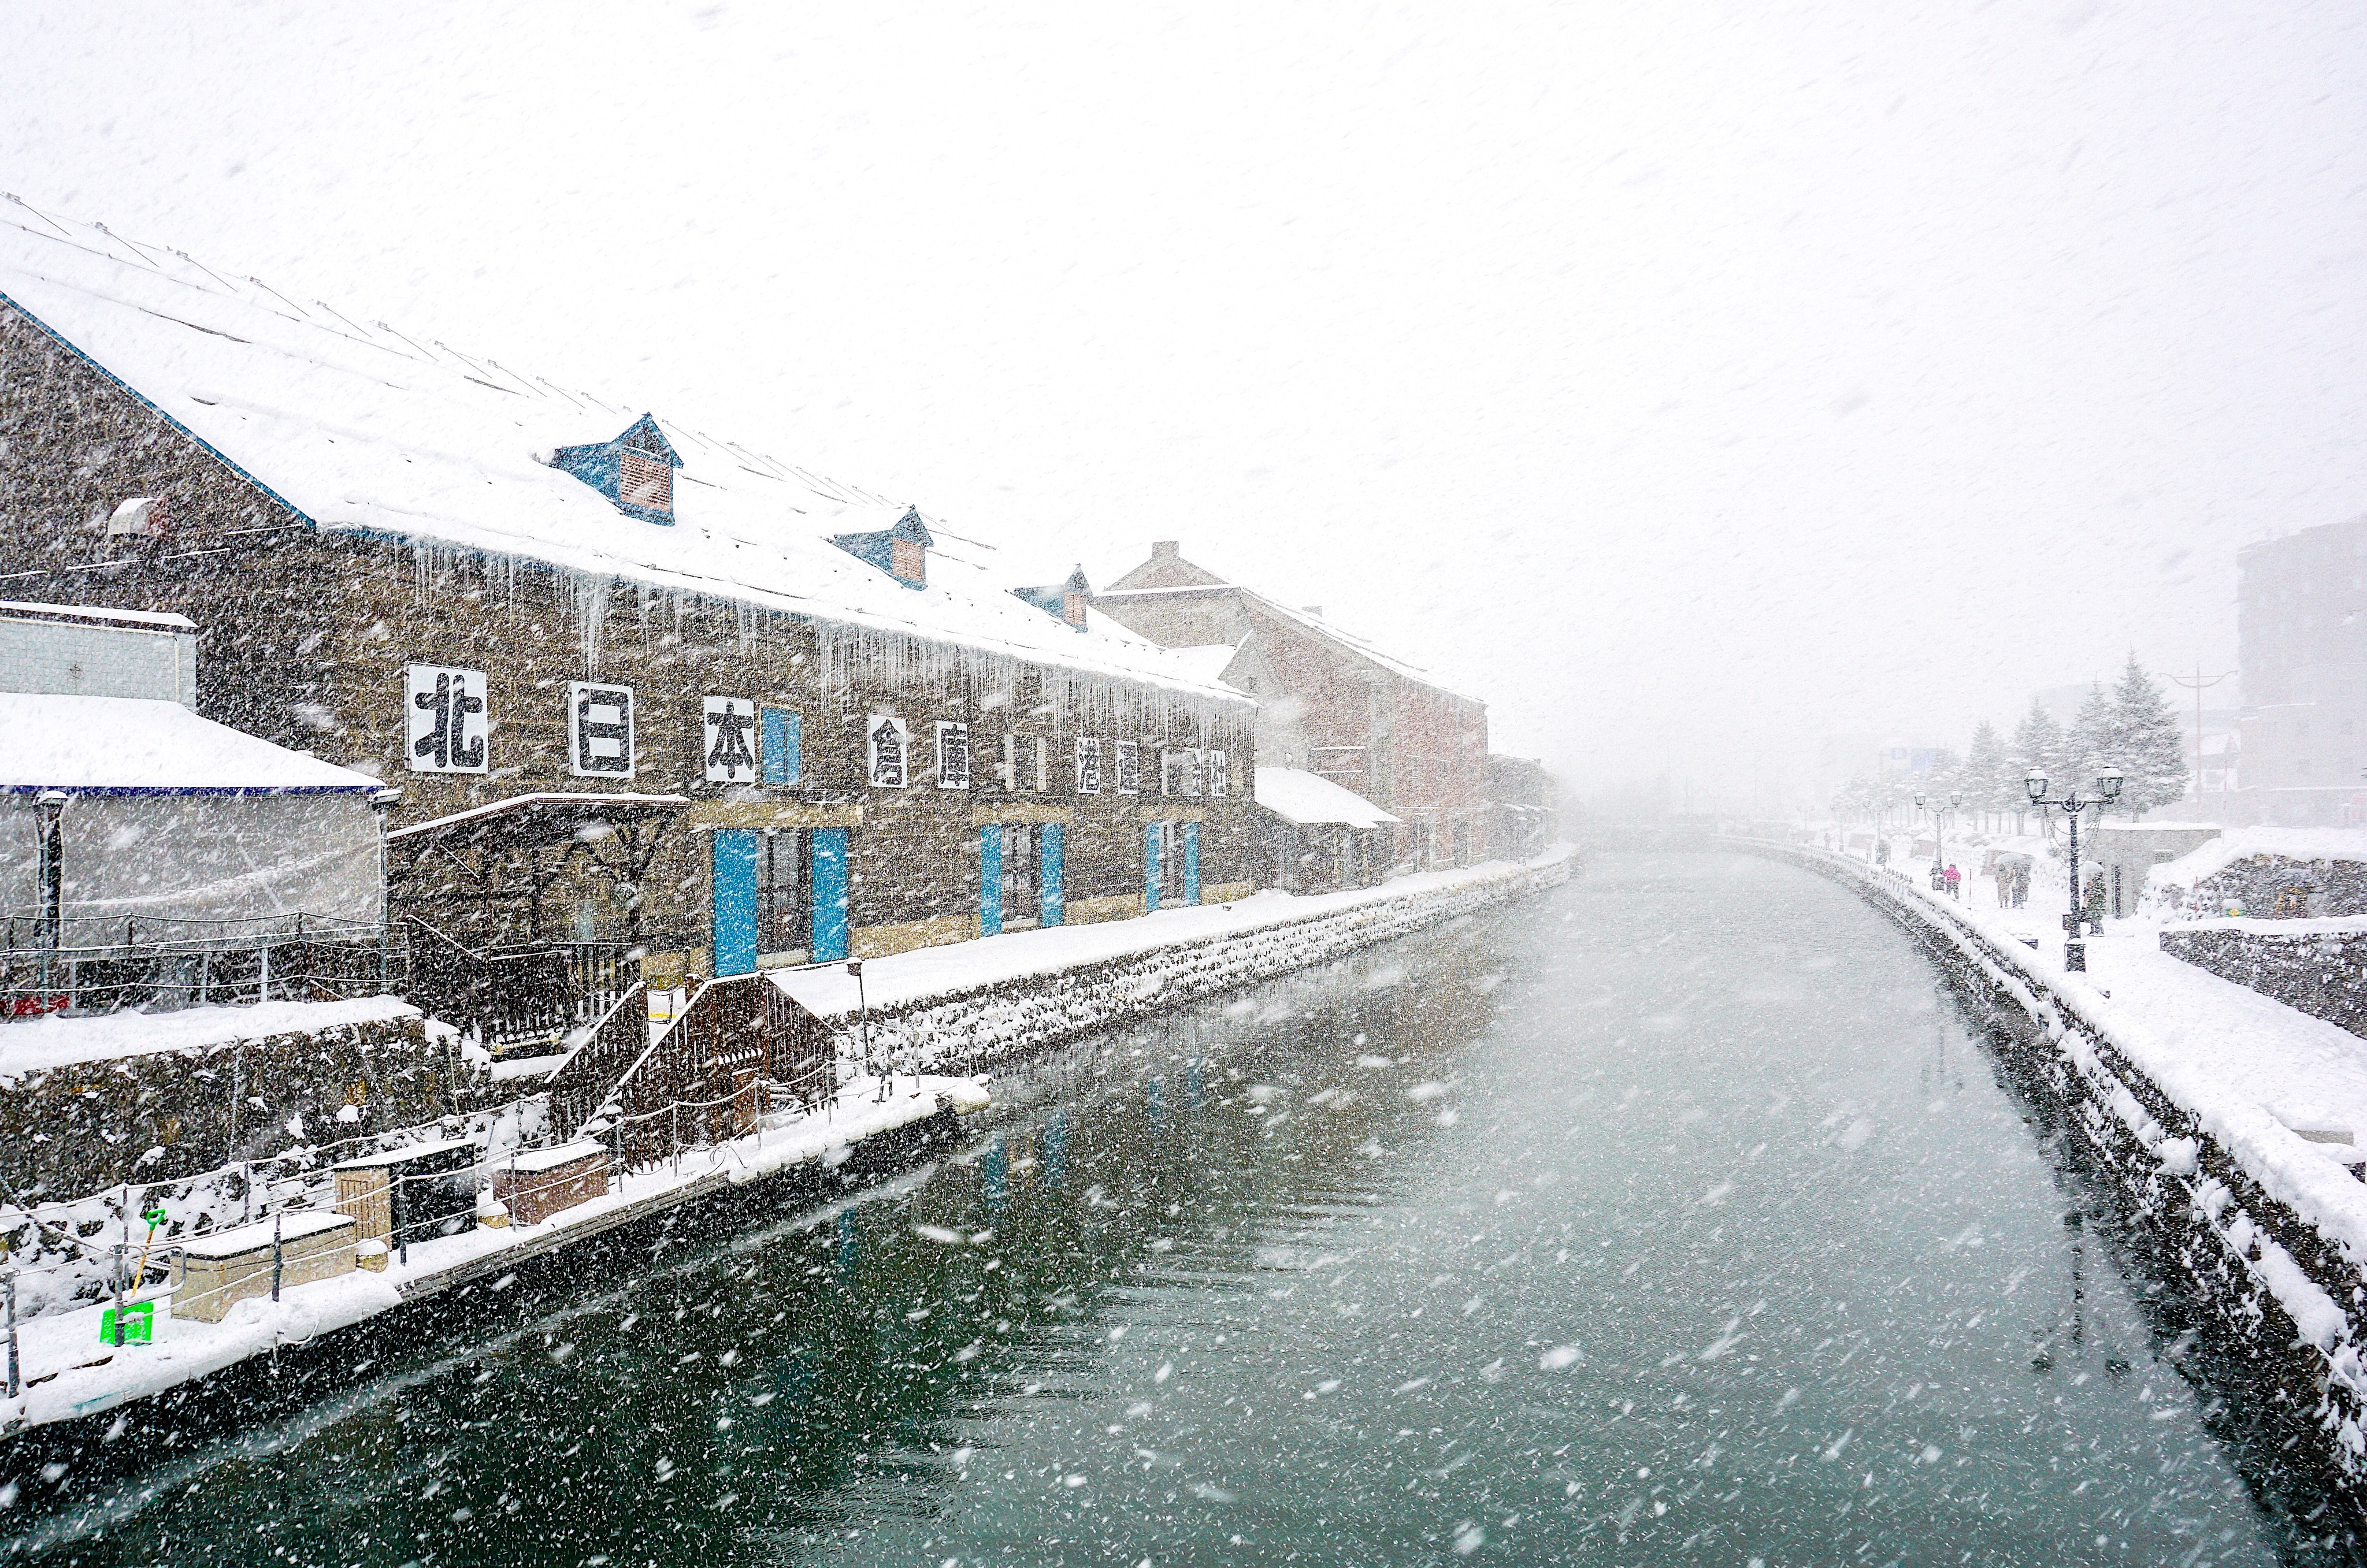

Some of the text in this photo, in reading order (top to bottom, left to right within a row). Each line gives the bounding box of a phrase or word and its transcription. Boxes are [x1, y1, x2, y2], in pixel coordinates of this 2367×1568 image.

[414, 672, 484, 768] 北
[578, 688, 630, 772] 日
[707, 701, 754, 779] 本
[872, 719, 906, 785] 倉
[940, 724, 969, 786] 庫
[1078, 740, 1099, 790] 港
